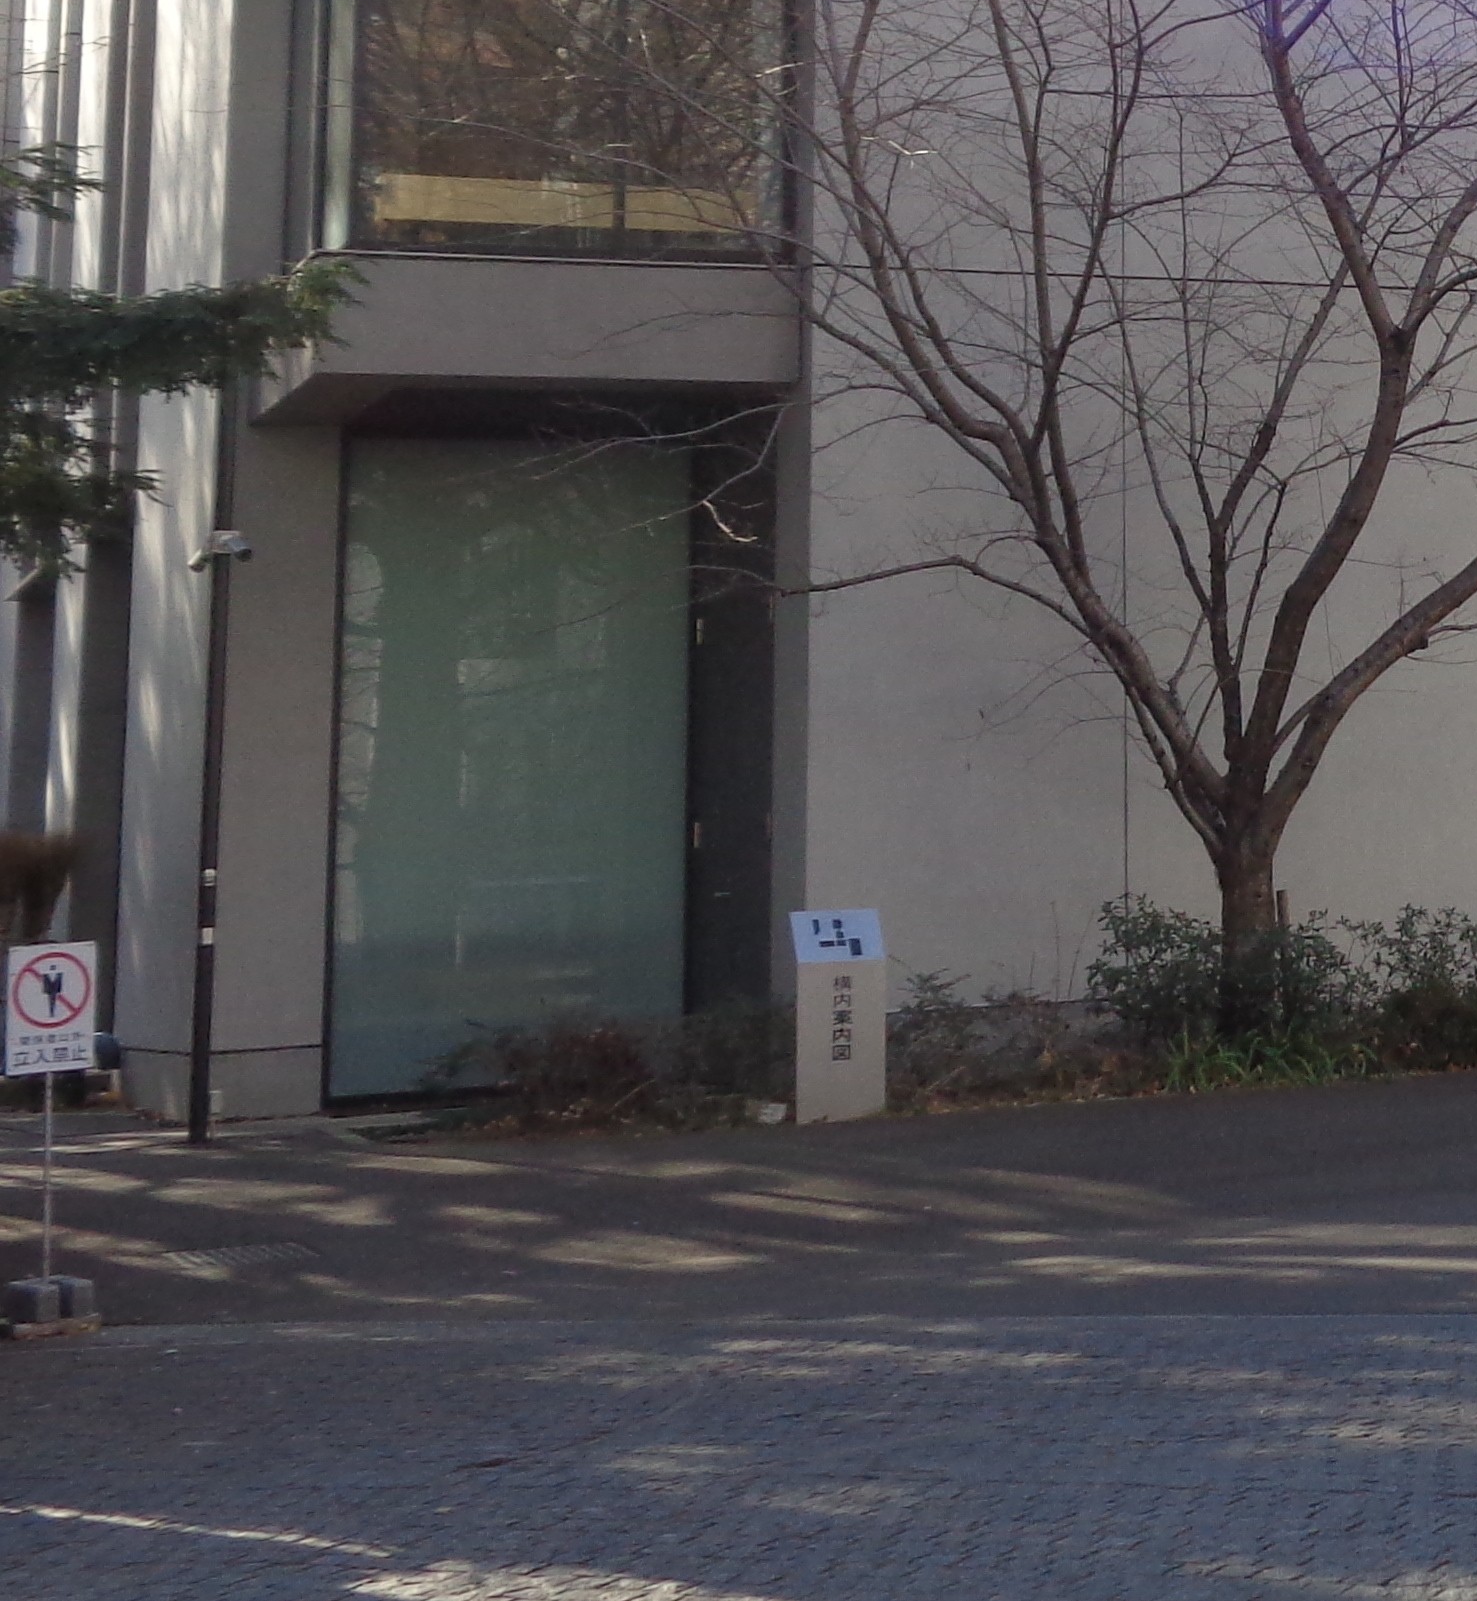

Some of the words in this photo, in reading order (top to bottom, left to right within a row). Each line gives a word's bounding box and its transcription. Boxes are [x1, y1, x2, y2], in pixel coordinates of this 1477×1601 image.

[832, 976, 852, 1061] 構内案内図
[13, 1046, 88, 1067] 立入禁止
